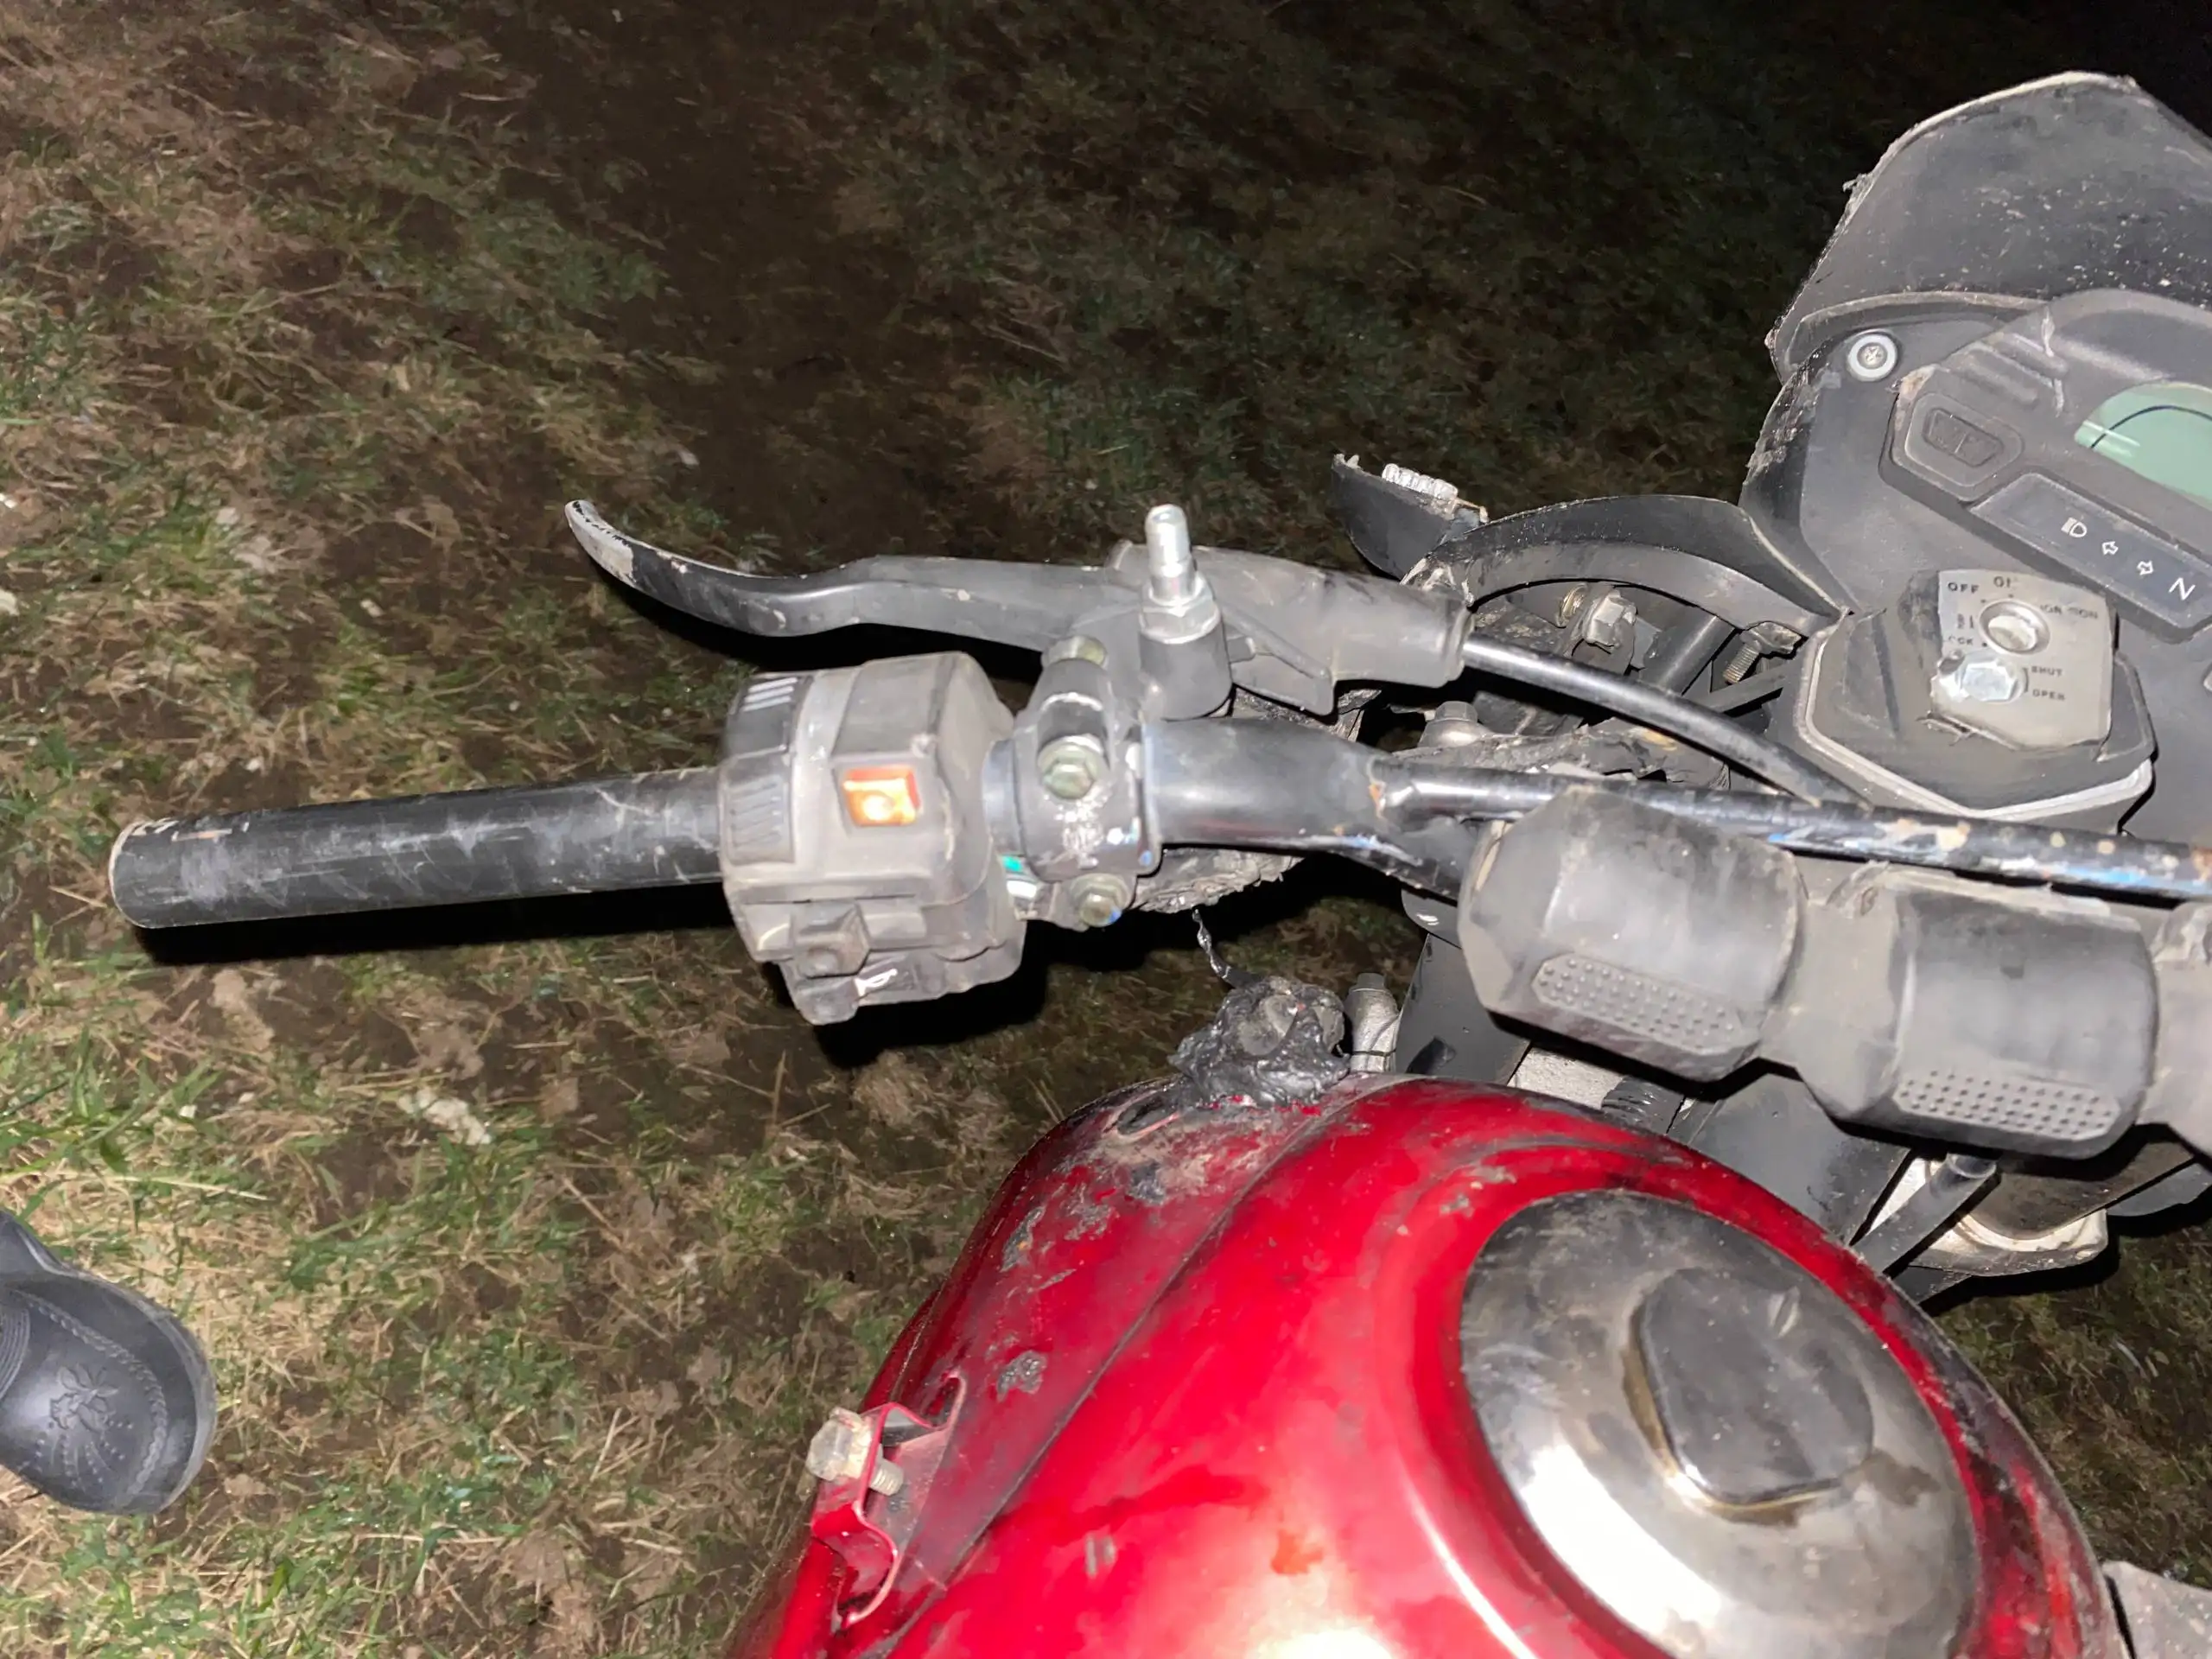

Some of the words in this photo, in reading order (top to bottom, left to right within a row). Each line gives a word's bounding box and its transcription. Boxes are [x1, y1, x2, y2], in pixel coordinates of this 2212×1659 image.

[1948, 582, 1980, 594] OFF
[2169, 577, 2196, 601] N
[2032, 688, 2066, 702] OPEN
